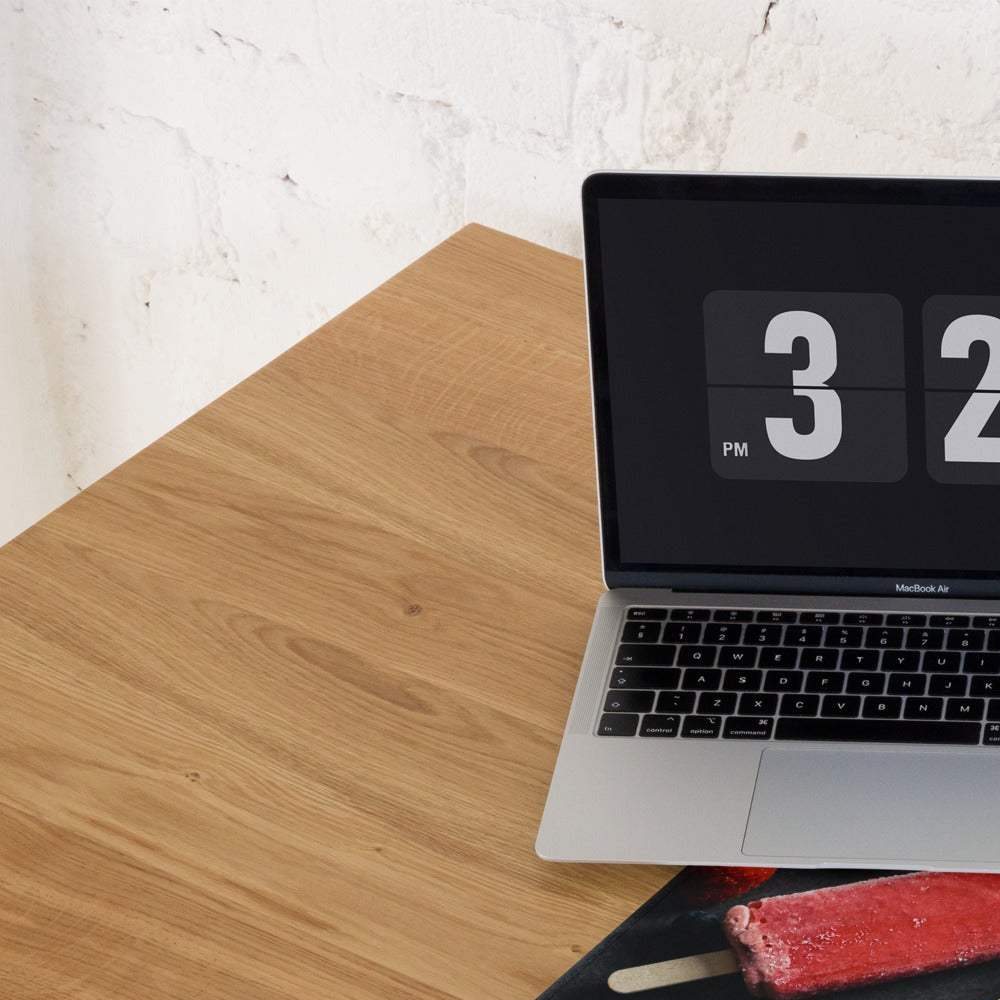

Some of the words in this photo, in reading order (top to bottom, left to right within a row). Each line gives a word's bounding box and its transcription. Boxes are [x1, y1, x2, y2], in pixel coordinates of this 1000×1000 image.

[764, 310, 843, 461] 3
[722, 441, 750, 459] PM
[895, 583, 937, 593] MacBook
[937, 584, 950, 593] Air
[718, 633, 726, 641] 2
[758, 634, 766, 642] 3
[798, 635, 806, 643] 4
[921, 638, 928, 646] 7
[961, 639, 969, 647] 8
[692, 651, 702, 660] Q
[732, 653, 744, 661] W
[774, 654, 782, 662] E
[856, 656, 864, 664] T
[897, 657, 905, 665] Y
[937, 657, 946, 666] U
[697, 675, 706, 683] A
[738, 676, 747, 684] S
[779, 677, 788, 685] D
[821, 678, 829, 686] F
[861, 679, 870, 687] G
[902, 680, 912, 688] H
[944, 681, 952, 689] J
[984, 682, 993, 690] K
[713, 699, 722, 707] Z
[754, 700, 763, 708] X
[795, 701, 805, 709] C
[837, 702, 846, 710] V
[877, 703, 886, 711] B
[919, 704, 928, 712] N
[959, 705, 970, 713] M
